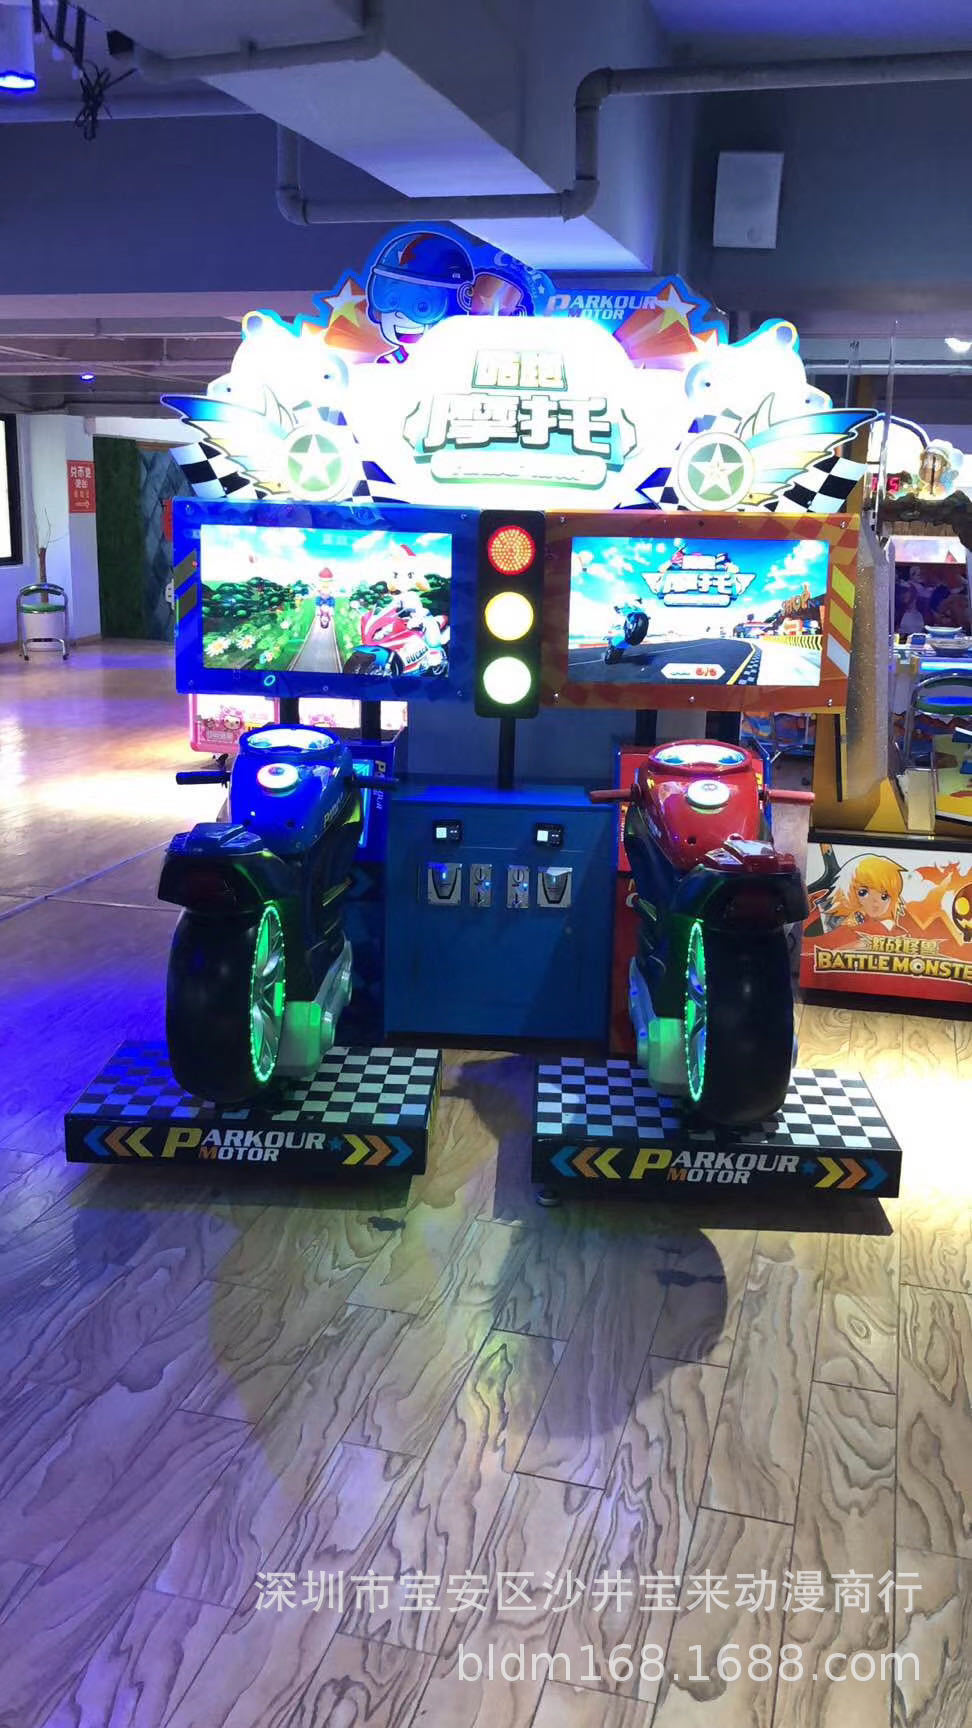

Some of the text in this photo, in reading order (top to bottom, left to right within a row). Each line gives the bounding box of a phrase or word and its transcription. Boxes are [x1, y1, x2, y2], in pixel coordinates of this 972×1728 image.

[548, 294, 657, 315] PARKOUR
[422, 392, 612, 460] 摩托
[817, 952, 889, 971] BATTLE
[160, 1127, 326, 1158] PARKOUR
[199, 1146, 279, 1162] MOTOR
[629, 1148, 800, 1179] PARKOUR
[667, 1168, 750, 1184] MOTOR
